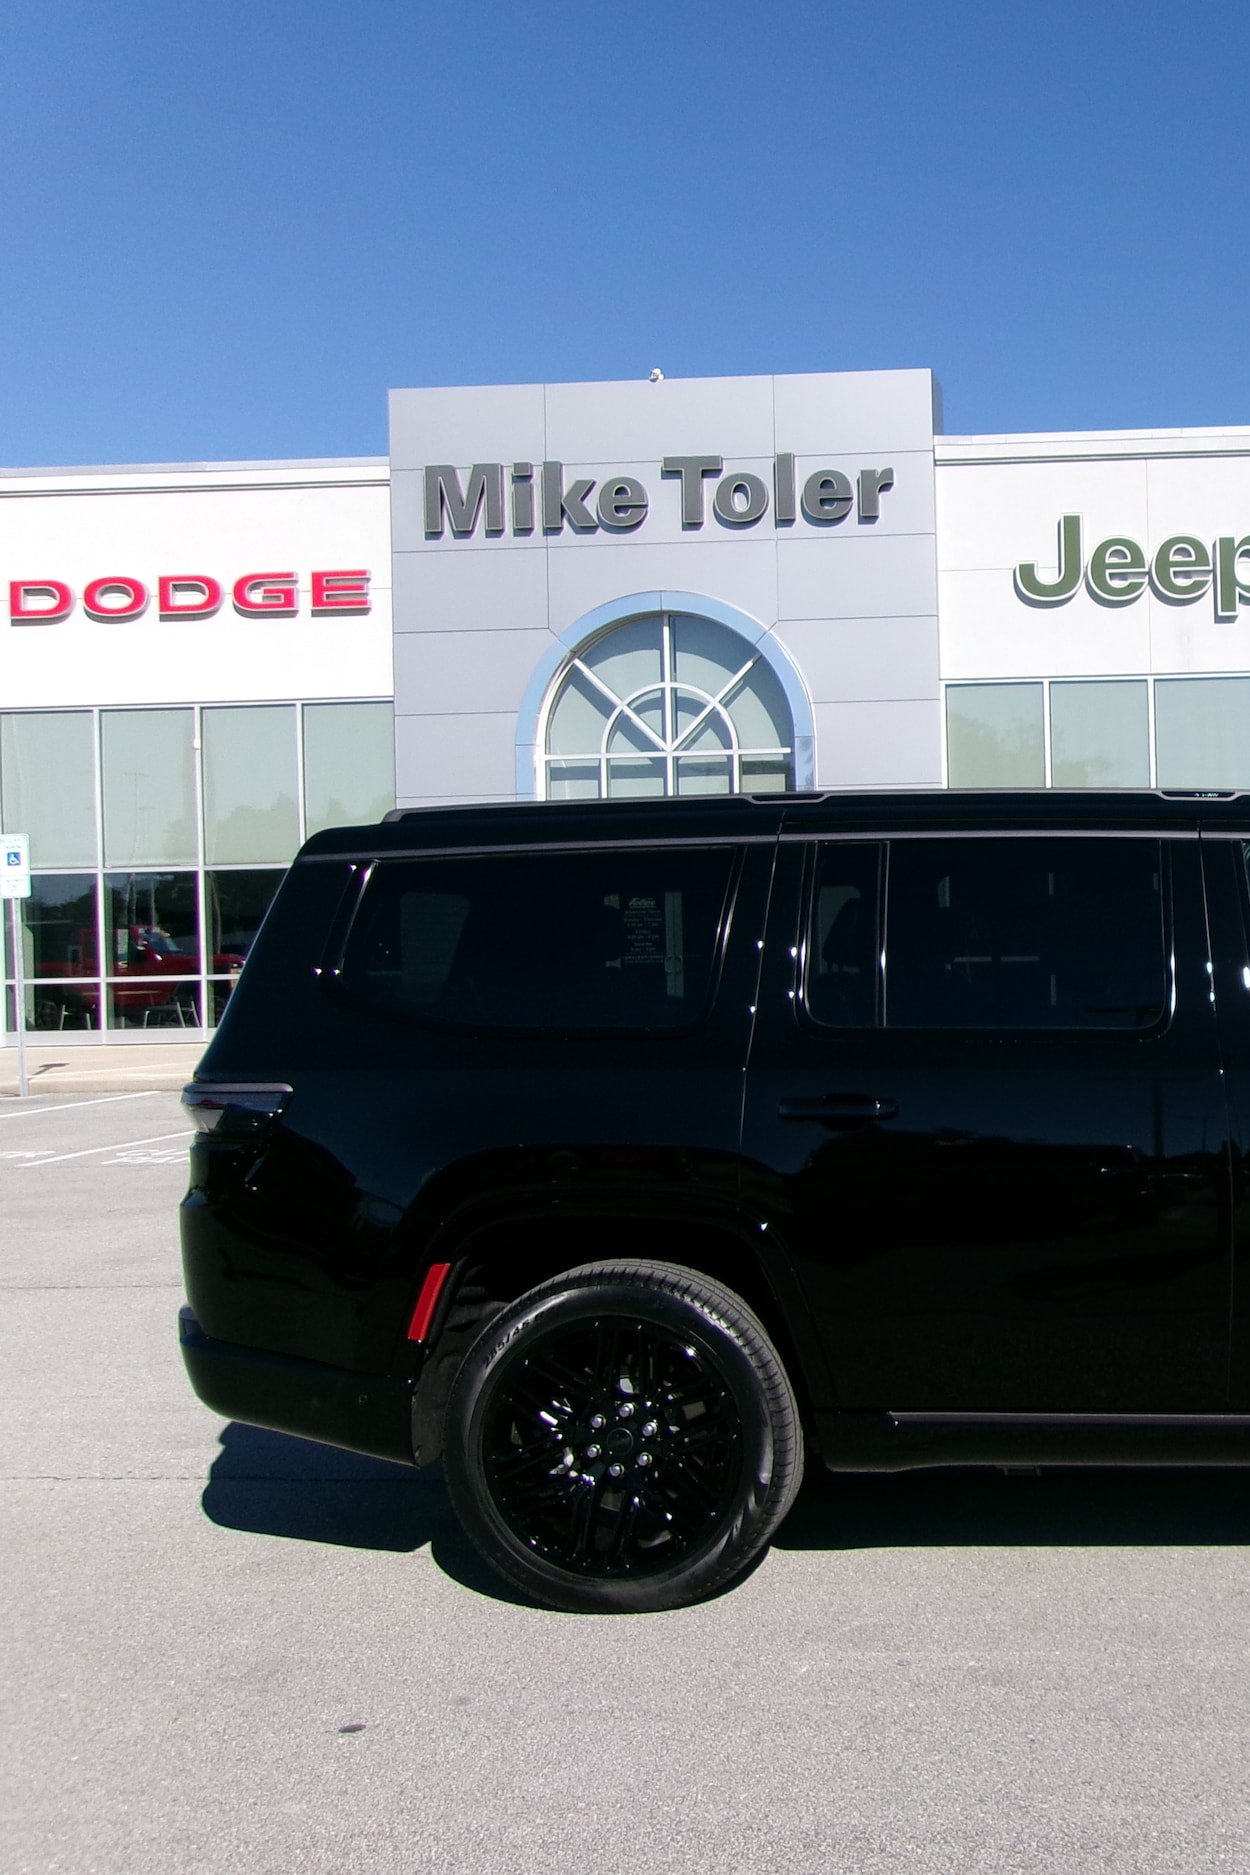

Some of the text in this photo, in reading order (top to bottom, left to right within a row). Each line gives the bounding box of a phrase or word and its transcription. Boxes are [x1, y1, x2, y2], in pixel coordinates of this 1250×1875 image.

[424, 451, 895, 538] Mike Toler
[9, 569, 372, 625] DODGE
